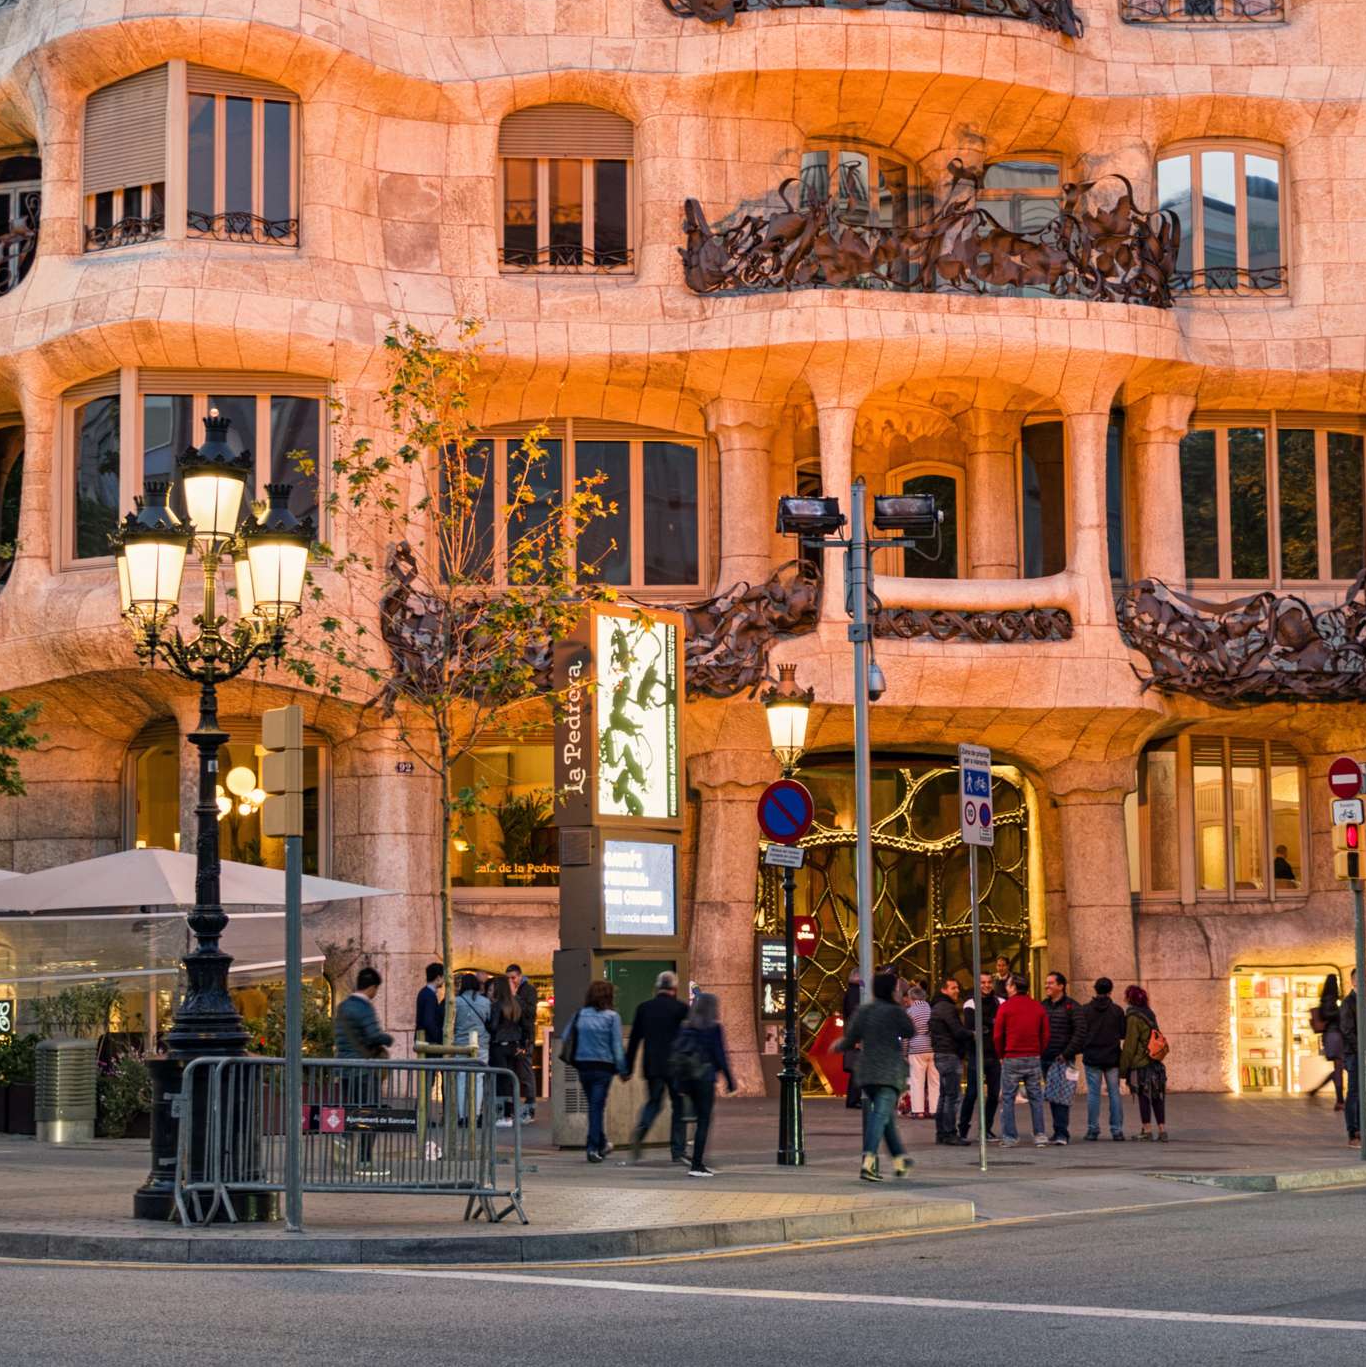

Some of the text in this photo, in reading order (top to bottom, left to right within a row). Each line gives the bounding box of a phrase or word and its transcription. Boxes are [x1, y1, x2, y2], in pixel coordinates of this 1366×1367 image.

[563, 660, 586, 794] La Pedrera
[399, 763, 412, 772] 92
[498, 863, 512, 873] de
[514, 863, 525, 873] la
[527, 863, 560, 873] Pedrer
